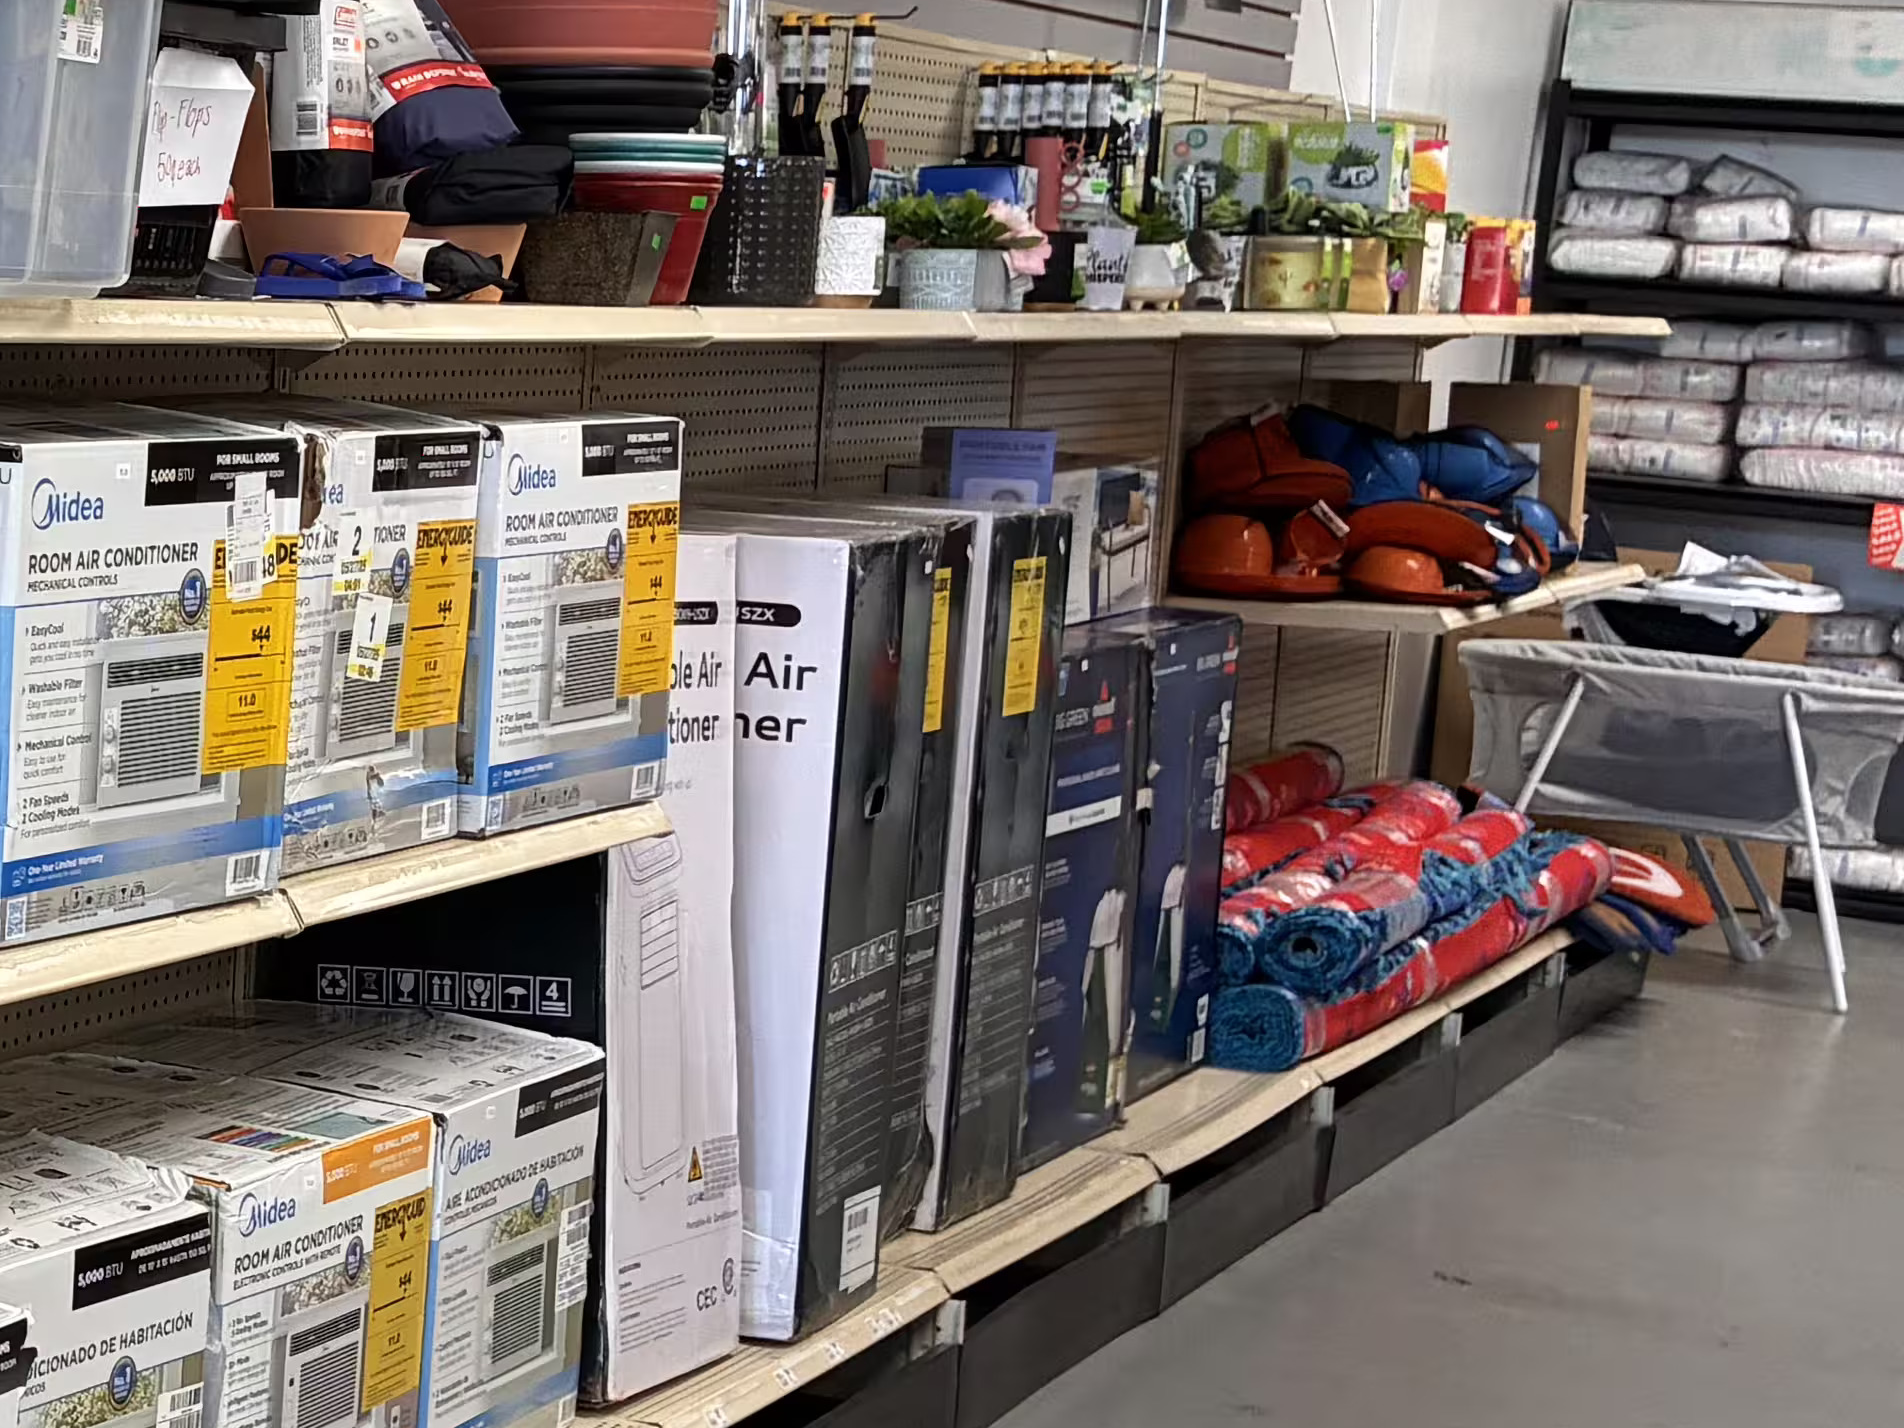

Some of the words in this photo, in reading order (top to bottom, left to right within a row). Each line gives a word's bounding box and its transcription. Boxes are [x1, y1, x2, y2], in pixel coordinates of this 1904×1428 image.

[506, 453, 556, 496] Midea
[31, 478, 105, 530] Midea
[505, 512, 536, 533] ROOM
[537, 510, 555, 530] AIR
[556, 506, 619, 528] CONDITIONER
[28, 551, 72, 575] ROOM
[75, 549, 101, 571] AIR
[104, 542, 199, 568] CONDITIONER
[27, 577, 77, 593] MECHANICAL
[77, 573, 118, 588] CONTROLS
[251, 625, 271, 643] $44
[697, 651, 723, 689] Air
[743, 651, 818, 691] Air
[448, 1133, 492, 1176] Midea
[464, 1163, 527, 1209] ACONDICIONADO
[539, 1144, 585, 1175] HABITACIÓN
[238, 1192, 297, 1238] Midea
[233, 1248, 271, 1276] ROOM
[271, 1241, 292, 1263] AIR
[293, 1213, 365, 1258] CONDITIONER
[696, 1285, 718, 1312] CEC
[117, 1310, 195, 1350] HABITACIÓN
